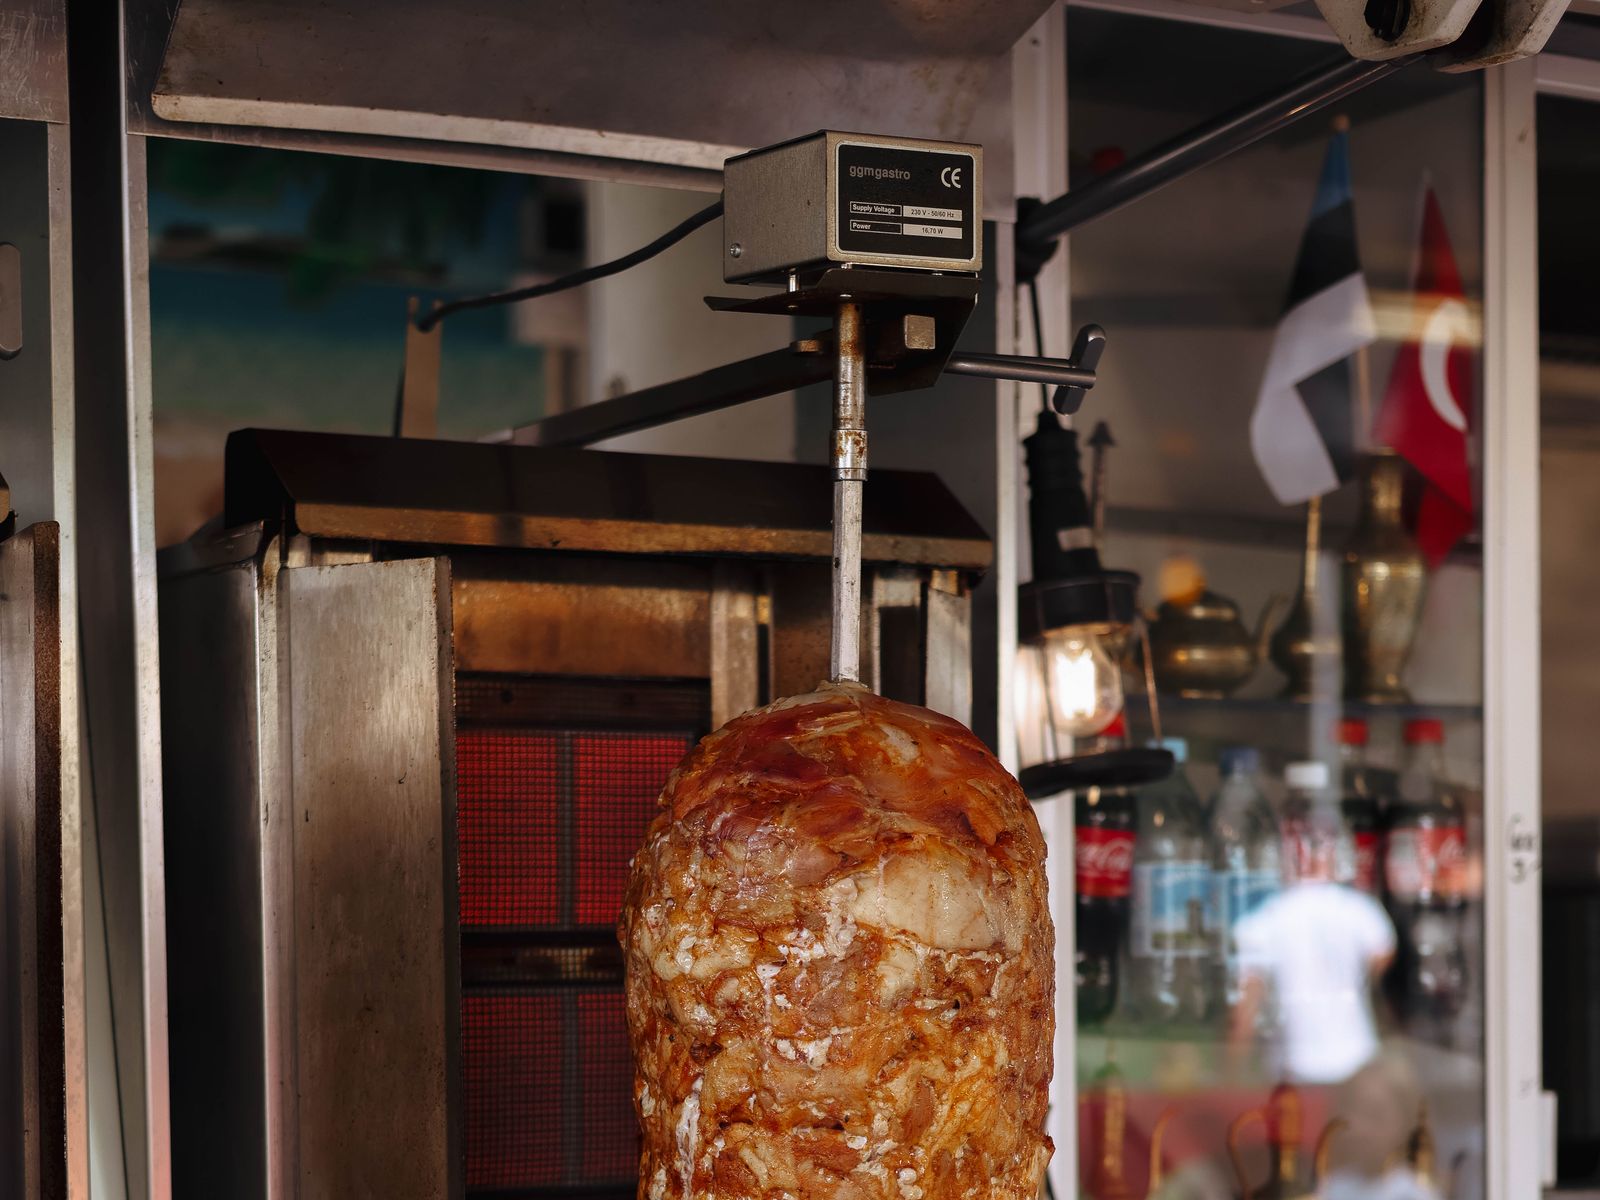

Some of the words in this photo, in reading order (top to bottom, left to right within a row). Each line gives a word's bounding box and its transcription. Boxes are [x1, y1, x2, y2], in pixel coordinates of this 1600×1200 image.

[849, 165, 910, 180] ggmgastro
[940, 167, 961, 189] CE
[853, 204, 873, 213] Supply
[874, 205, 895, 215] Voltage
[852, 222, 871, 230] Power
